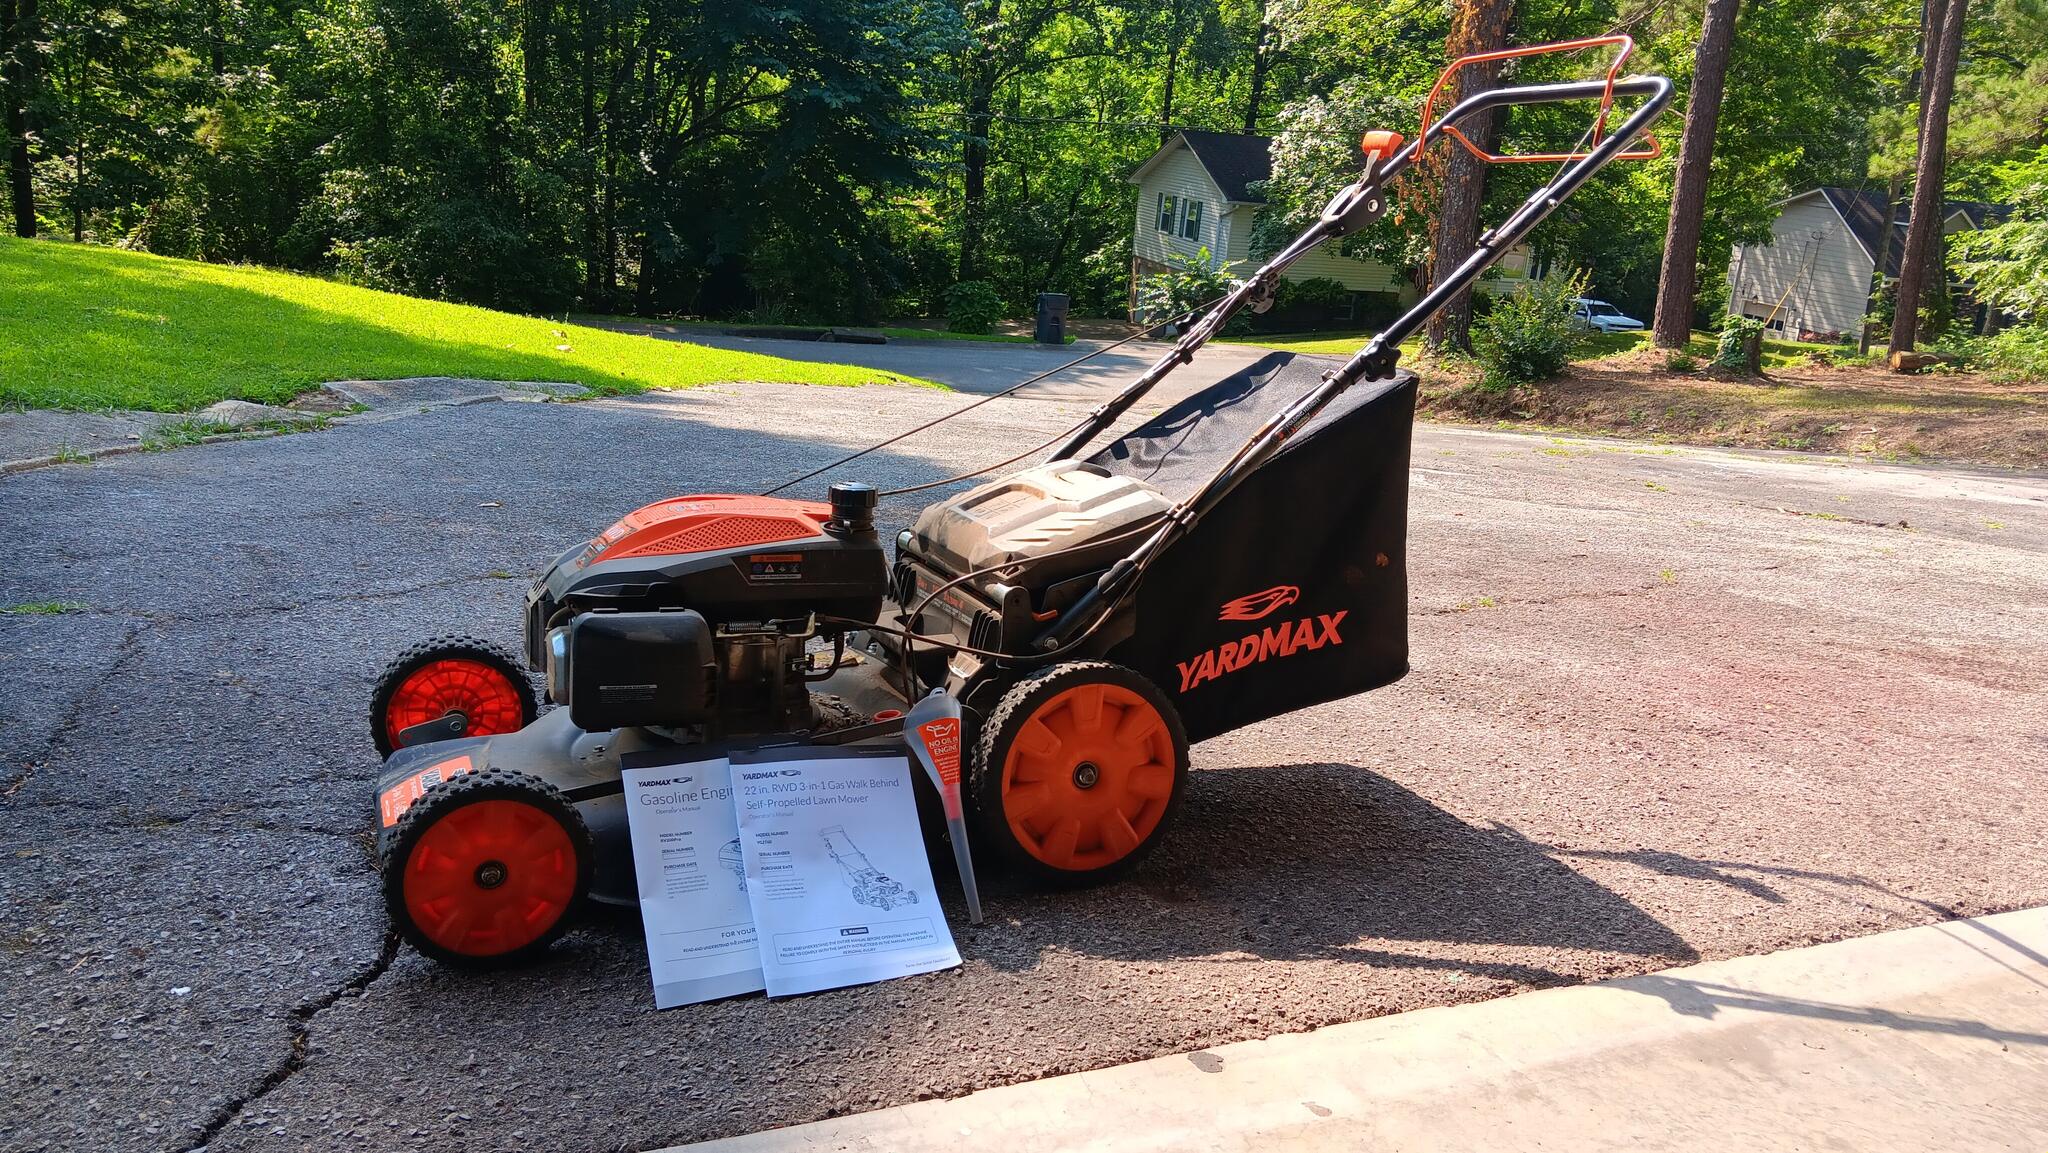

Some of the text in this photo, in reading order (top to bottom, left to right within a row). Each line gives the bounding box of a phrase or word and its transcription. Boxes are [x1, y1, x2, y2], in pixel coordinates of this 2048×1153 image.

[1176, 610, 1348, 693] YARDMAX
[929, 740, 941, 749] NO
[742, 771, 779, 780] YARDMAX
[638, 779, 671, 788] YARDMAX
[744, 778, 900, 795] 22 in. RWD 3-in-1 Gas Walk Behind
[640, 791, 698, 806] Gasoline
[746, 795, 869, 810] Self-Propelled Lawn Mower
[736, 927, 756, 935] YOUR
